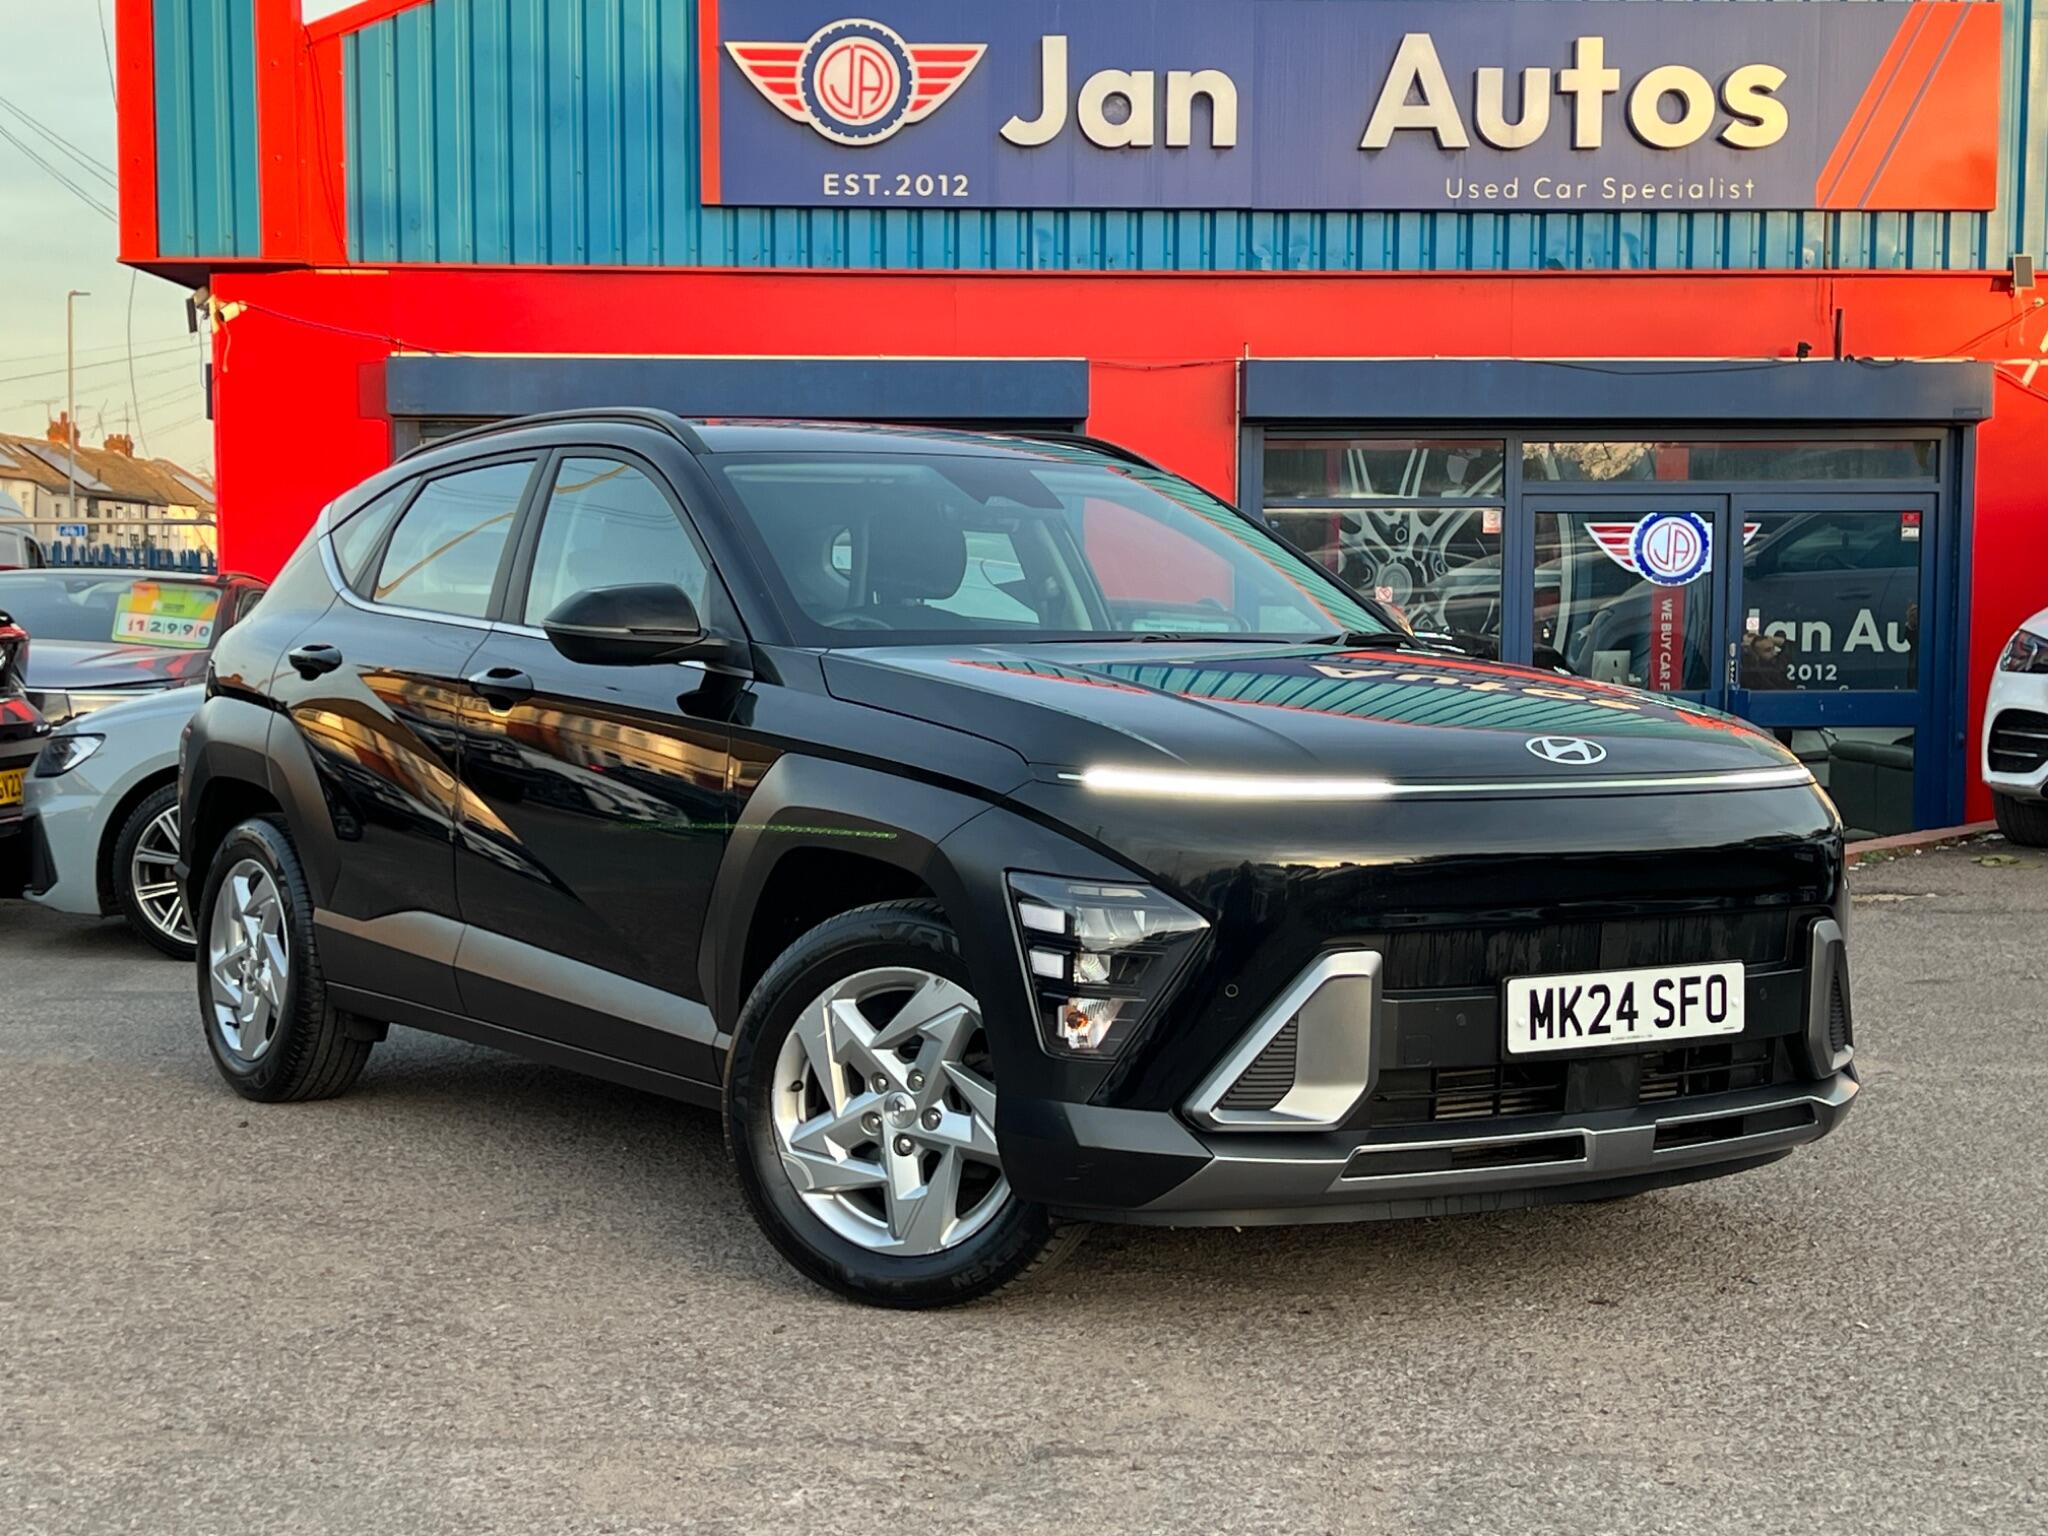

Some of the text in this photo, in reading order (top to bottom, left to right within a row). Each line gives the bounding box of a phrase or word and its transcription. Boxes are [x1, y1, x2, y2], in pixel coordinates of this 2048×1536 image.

[1000, 33, 1789, 149] Jan Autos
[1446, 176, 1755, 205] Used Car Specialist
[1661, 598, 1673, 621] WE
[1660, 623, 1673, 651] BUY
[1659, 652, 1671, 680] CAR
[1529, 973, 1728, 1040] MK24 SFO
